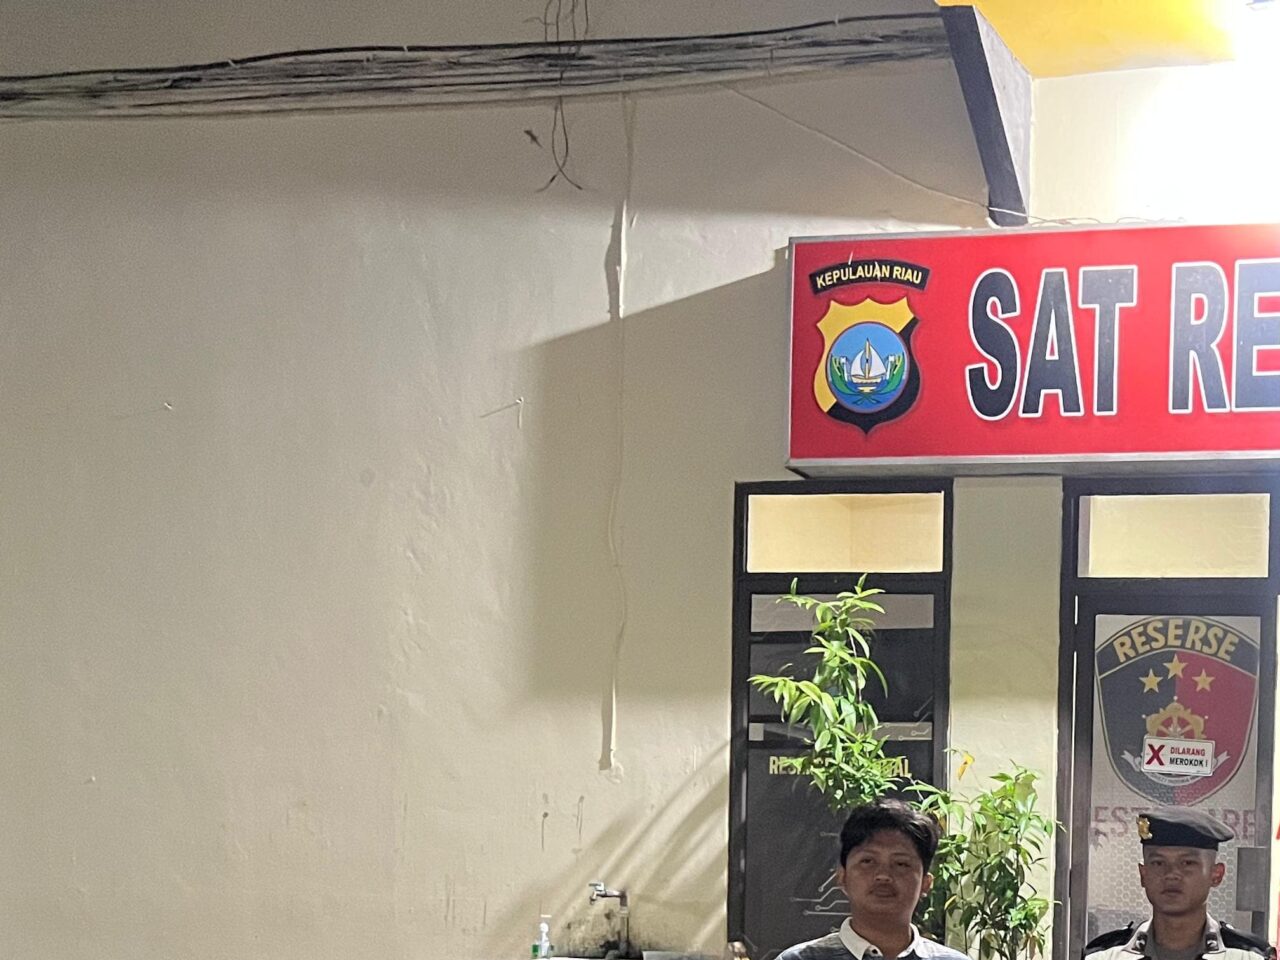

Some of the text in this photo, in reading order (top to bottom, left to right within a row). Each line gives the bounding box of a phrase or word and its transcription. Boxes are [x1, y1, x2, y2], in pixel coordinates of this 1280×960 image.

[815, 264, 923, 289] KEPULAUAN RIAU
[965, 264, 1138, 421] SAT
[1112, 618, 1240, 663] RESERSE
[1169, 757, 1203, 767] MEROKOK
[1170, 746, 1206, 757] DILARANG
